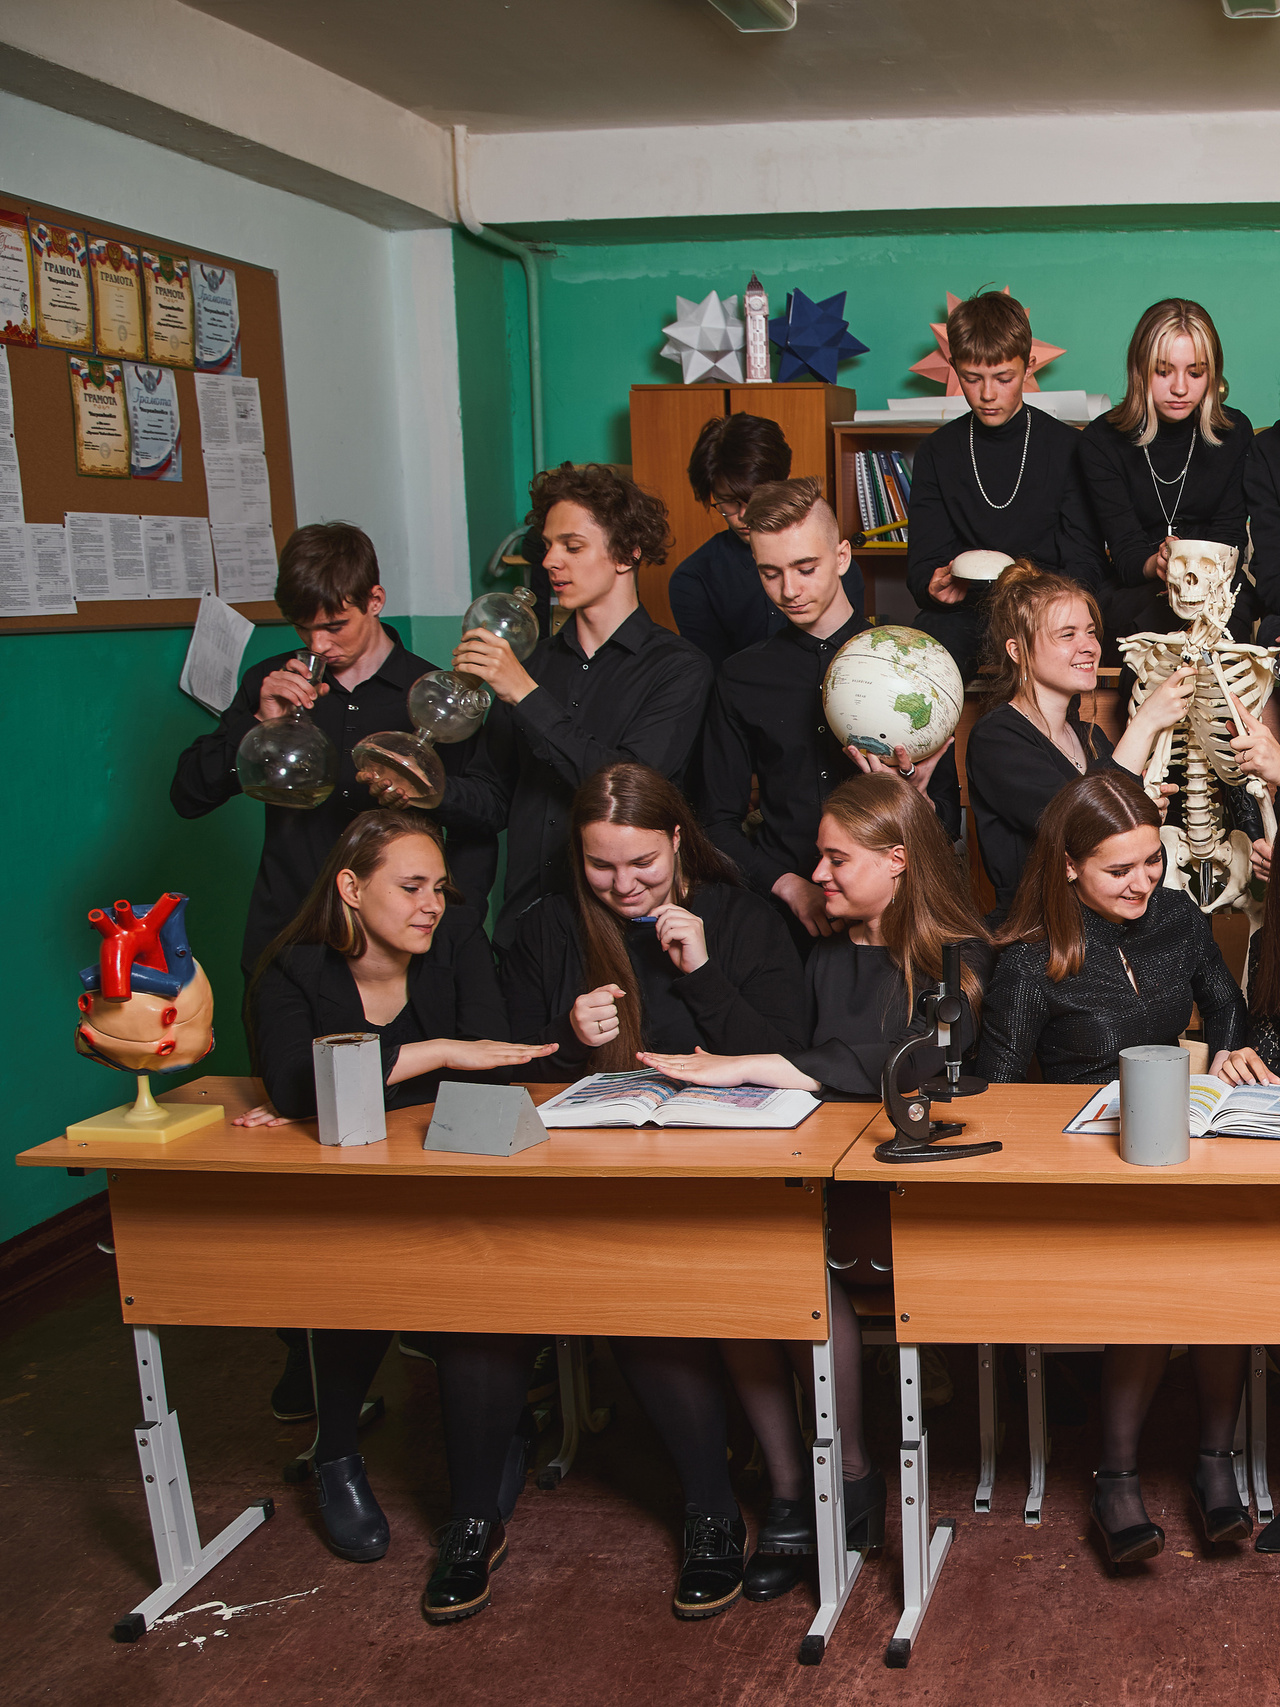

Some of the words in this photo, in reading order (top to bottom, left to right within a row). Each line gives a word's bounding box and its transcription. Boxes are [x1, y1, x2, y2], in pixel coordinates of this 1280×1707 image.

[44, 261, 82, 279] ГРАМОТА
[100, 271, 134, 287] ГРАМОТА
[155, 286, 185, 300] ГРАМОТА
[197, 284, 232, 306] Грамота
[83, 393, 117, 406] ГРАМОТА
[132, 387, 172, 407] Грамота
